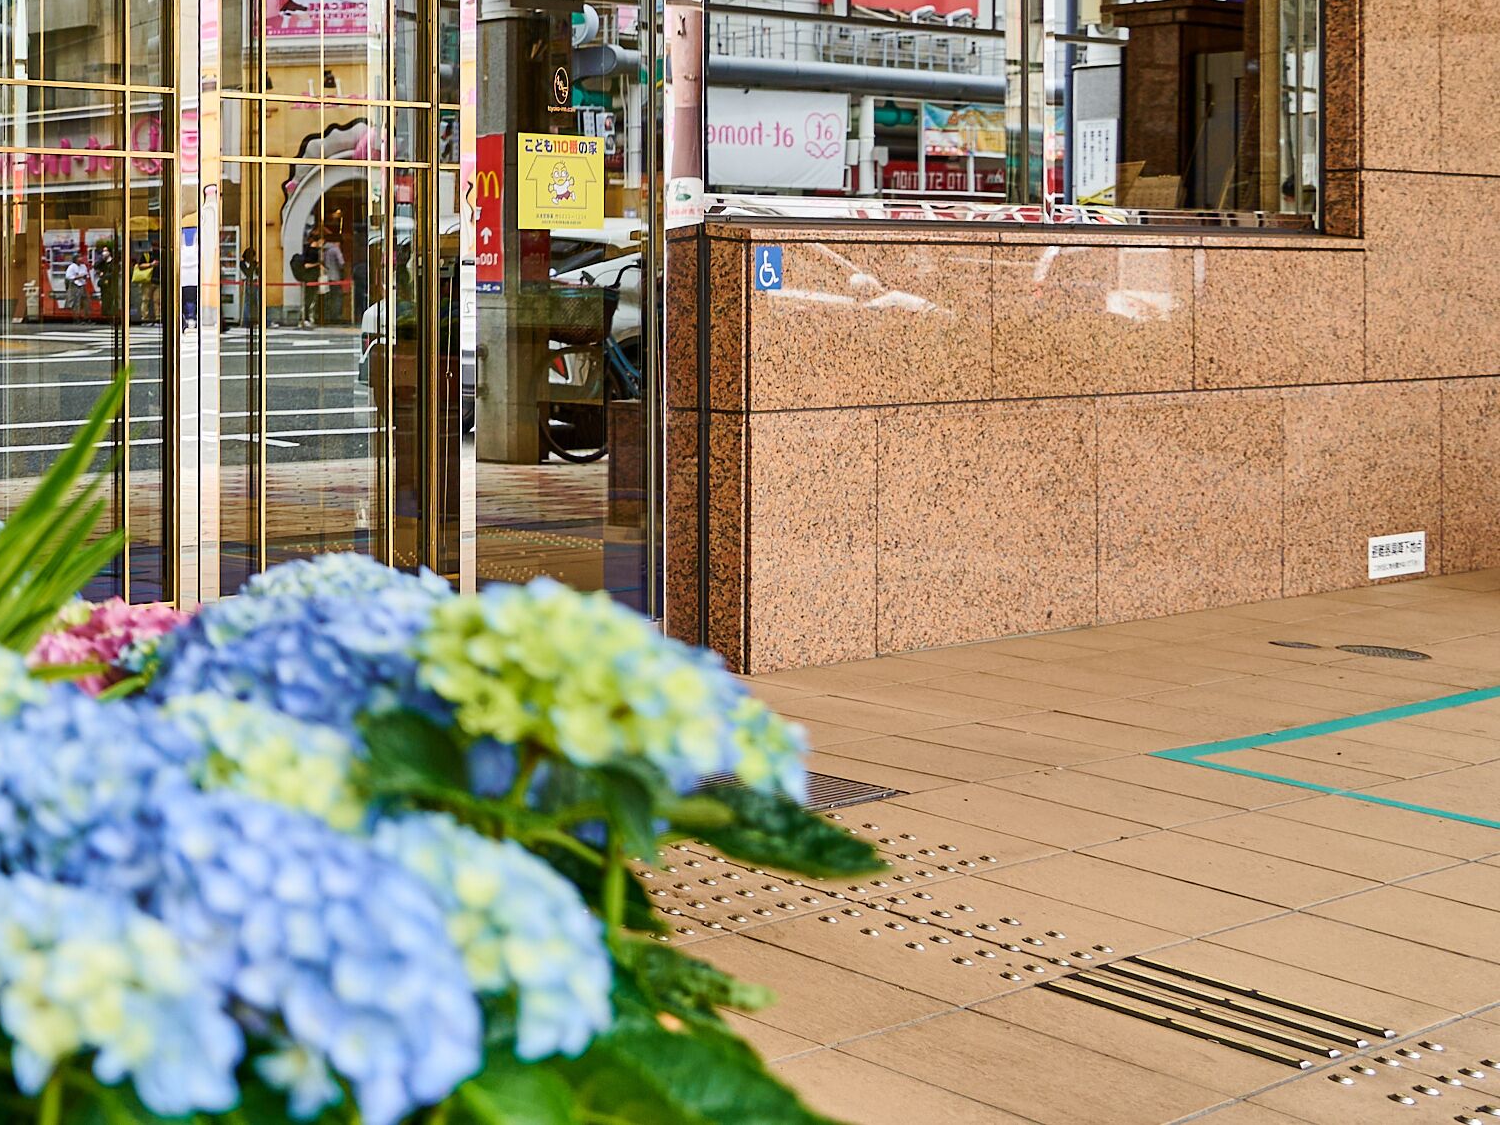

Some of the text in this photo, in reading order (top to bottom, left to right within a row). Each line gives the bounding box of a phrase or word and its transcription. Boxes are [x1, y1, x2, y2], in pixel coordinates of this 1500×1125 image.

[525, 139, 598, 155] こども110番の家
